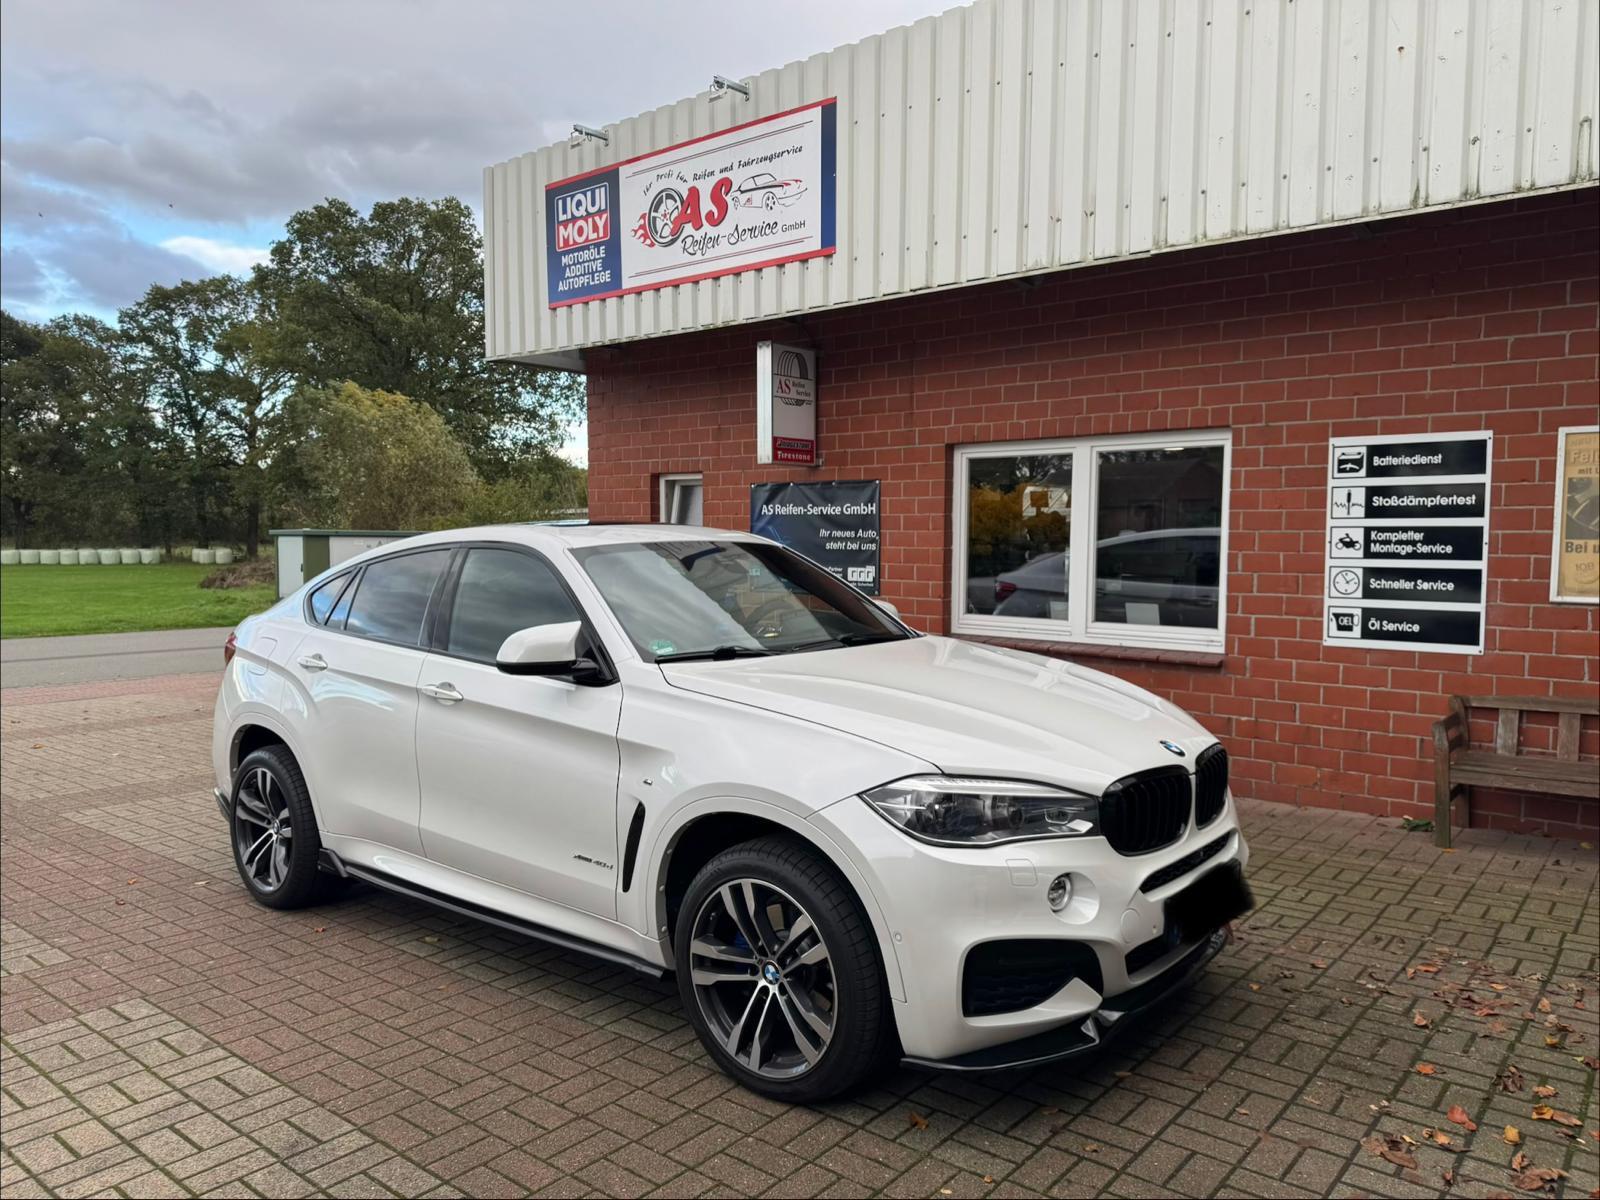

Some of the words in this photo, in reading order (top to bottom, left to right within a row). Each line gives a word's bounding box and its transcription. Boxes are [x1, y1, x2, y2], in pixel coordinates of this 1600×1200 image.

[692, 169, 715, 182] Reifen
[719, 162, 733, 174] und
[737, 145, 803, 169] Fahrzeugservice
[558, 187, 606, 222] LIQUI
[670, 177, 733, 238] AS
[559, 213, 608, 248] MOLY
[781, 220, 806, 233] GmbH
[561, 245, 606, 267] MOTORÖLE
[565, 260, 602, 278] ADDITIVE
[558, 270, 611, 287] AUTOPFLEGE
[776, 377, 791, 395] AS
[1373, 453, 1442, 466] Batteriedienst
[762, 504, 773, 515] AS
[775, 503, 841, 515] Reifen-Service
[843, 502, 876, 515] GmbH
[1372, 494, 1476, 509] Stoßdämpfertest
[820, 529, 830, 538] Ihr
[831, 530, 855, 538] neues
[1370, 531, 1424, 542] Kompletter
[825, 541, 845, 550] steht
[847, 541, 859, 550] bei
[1370, 542, 1453, 555] Montage-Service
[1565, 541, 1588, 554] Bei
[1369, 578, 1413, 590] Schneller
[1416, 579, 1455, 591] Service
[1338, 616, 1352, 626] OEL
[1368, 617, 1380, 630] Öl
[1382, 620, 1420, 632] Service
